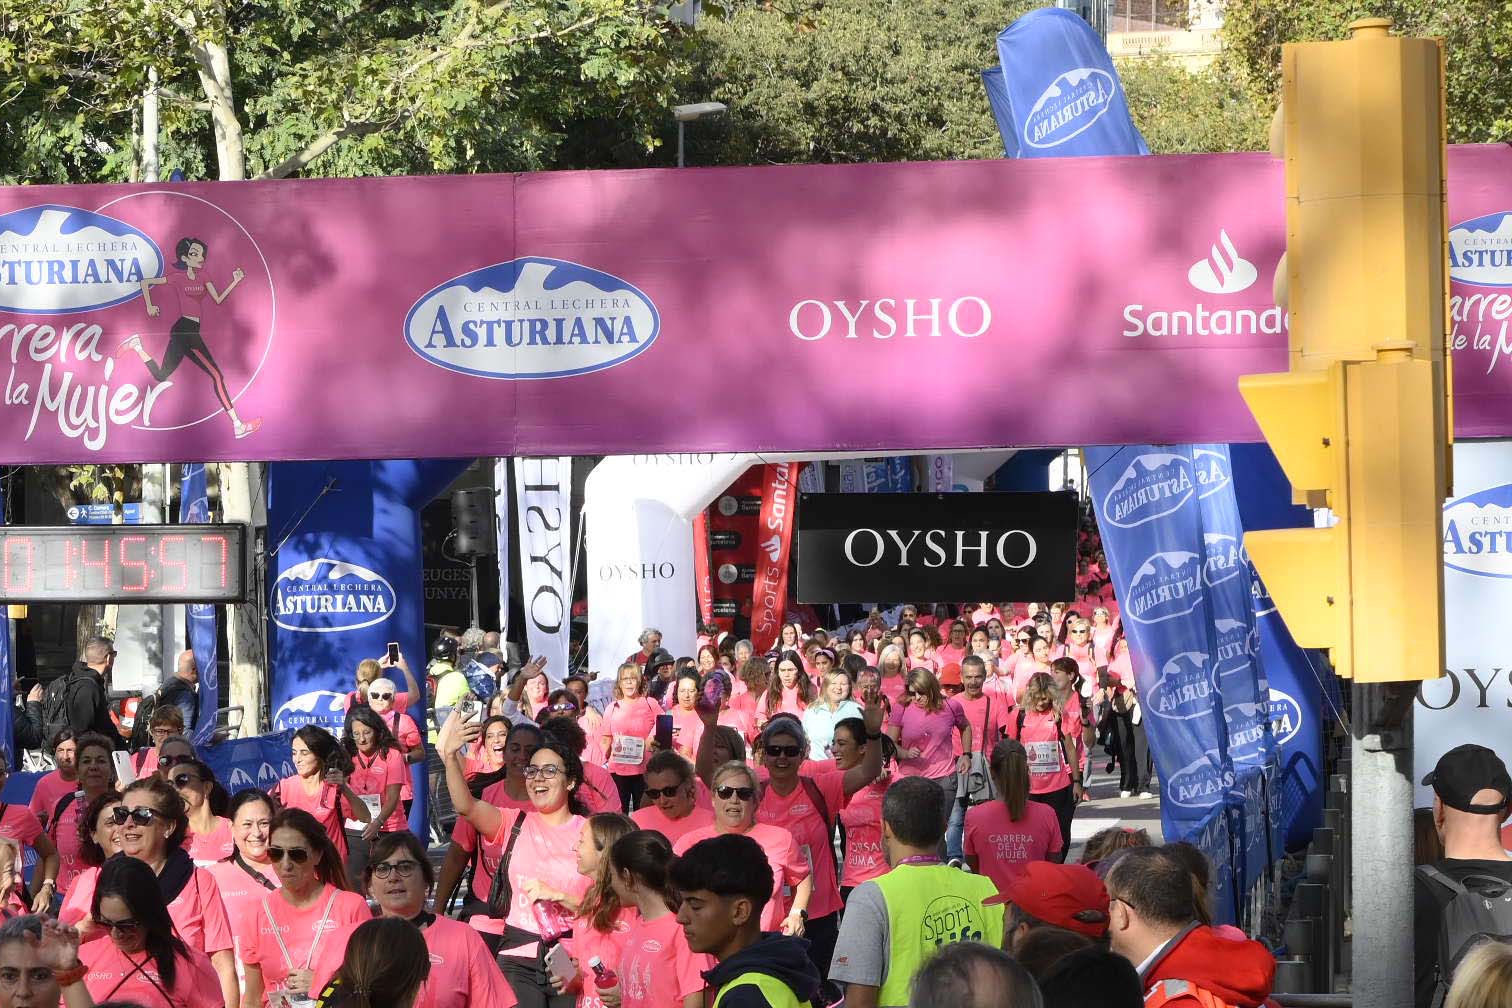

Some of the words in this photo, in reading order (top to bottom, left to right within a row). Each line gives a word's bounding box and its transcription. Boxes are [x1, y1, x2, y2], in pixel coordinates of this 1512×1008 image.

[63, 241, 138, 253] LECHERA
[463, 298, 543, 314] CENTRAL
[549, 296, 632, 313] LECHERA
[788, 295, 993, 341] OYSHO
[424, 305, 640, 352] ASTURIANA
[1473, 322, 1491, 350] la
[4, 365, 30, 406] la
[24, 358, 175, 451] Mujer
[844, 529, 1038, 569] OYSHO
[3, 536, 228, 591] 01:45:57
[599, 562, 676, 582] OYSHO
[274, 588, 387, 615] ASTURIANA
[286, 584, 328, 592] CENTRAL
[334, 584, 383, 592] LECHERA
[756, 567, 780, 637] Sports
[288, 716, 328, 724] CENTRAL
[989, 834, 1034, 843] CARRERA
[998, 843, 1012, 851] DE
[1014, 843, 1026, 851] LA
[996, 851, 1028, 859] MUJER
[925, 902, 972, 941] Sport
